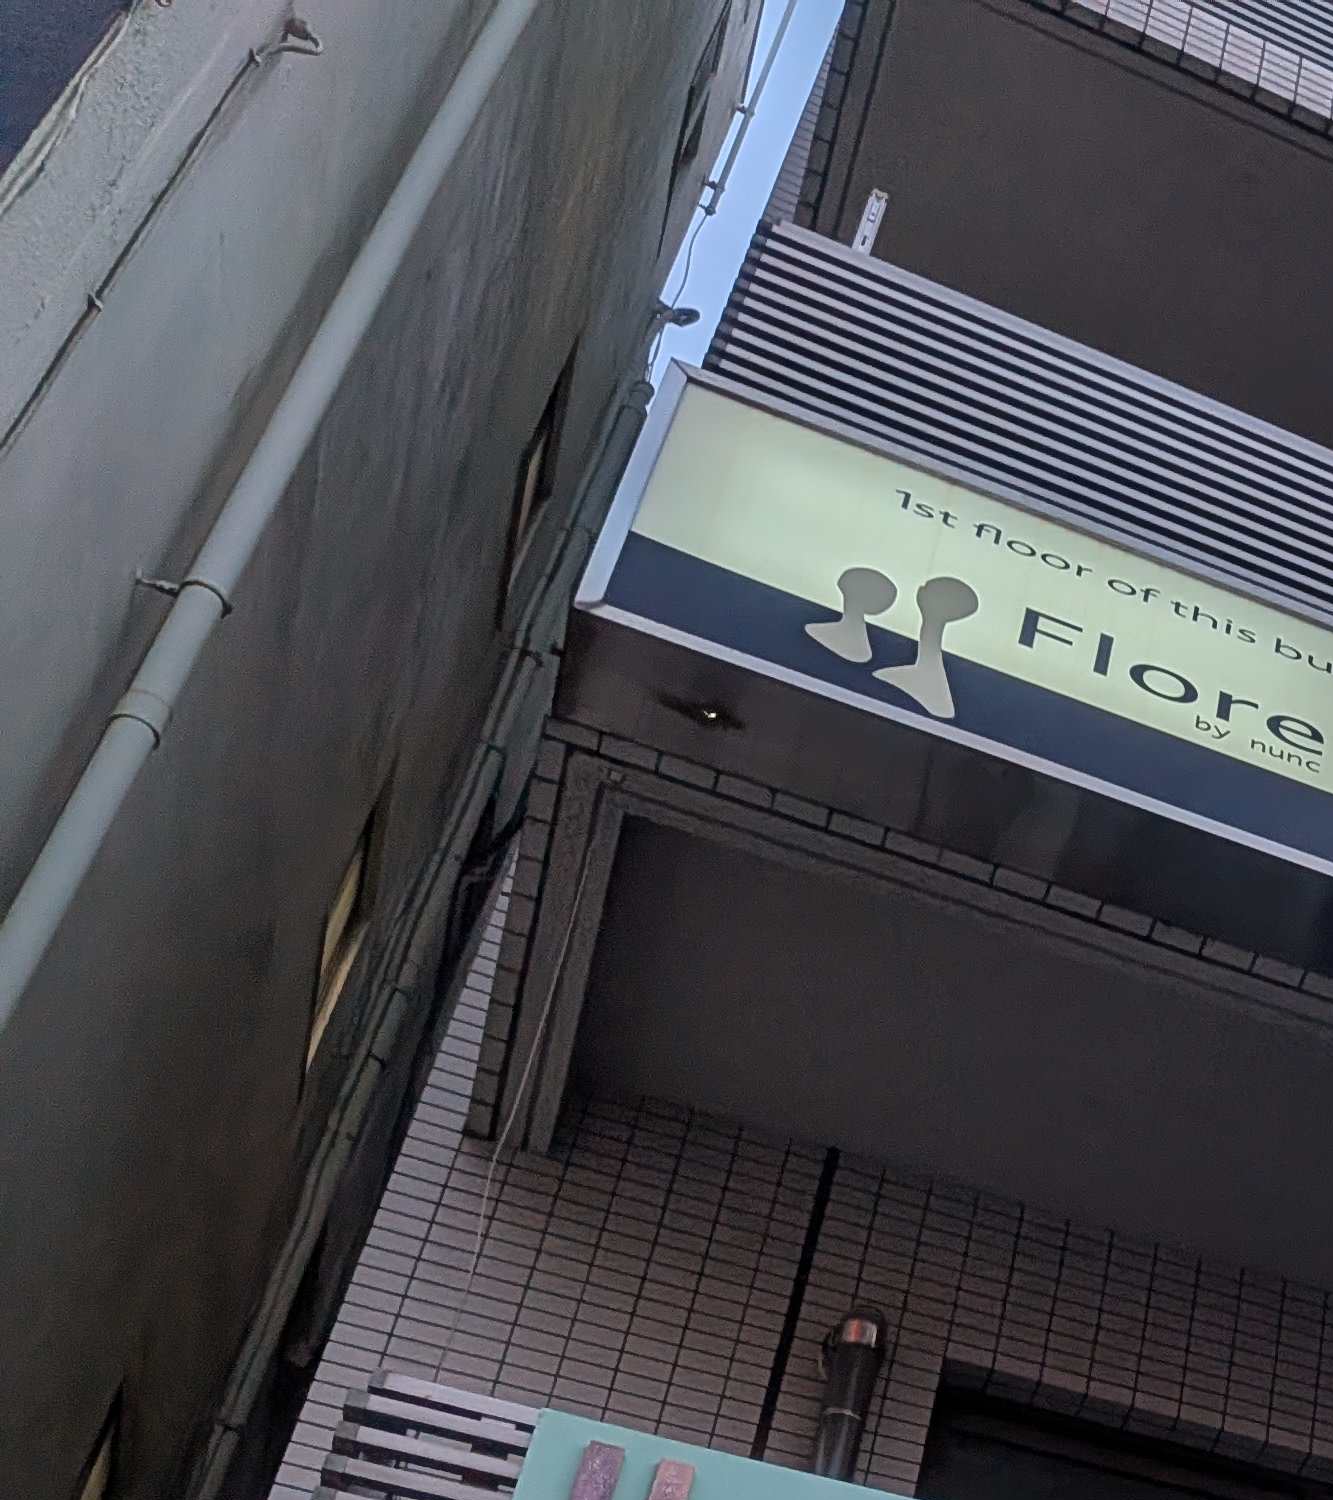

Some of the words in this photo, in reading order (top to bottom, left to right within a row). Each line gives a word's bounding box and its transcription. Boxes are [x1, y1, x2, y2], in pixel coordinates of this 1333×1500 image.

[894, 487, 959, 529] 1st
[971, 516, 1094, 579] floor
[1107, 572, 1159, 606] of
[1170, 596, 1257, 646] this
[1016, 606, 1326, 756] Flore
[1193, 712, 1231, 741] by
[1248, 734, 1322, 774] nunc
